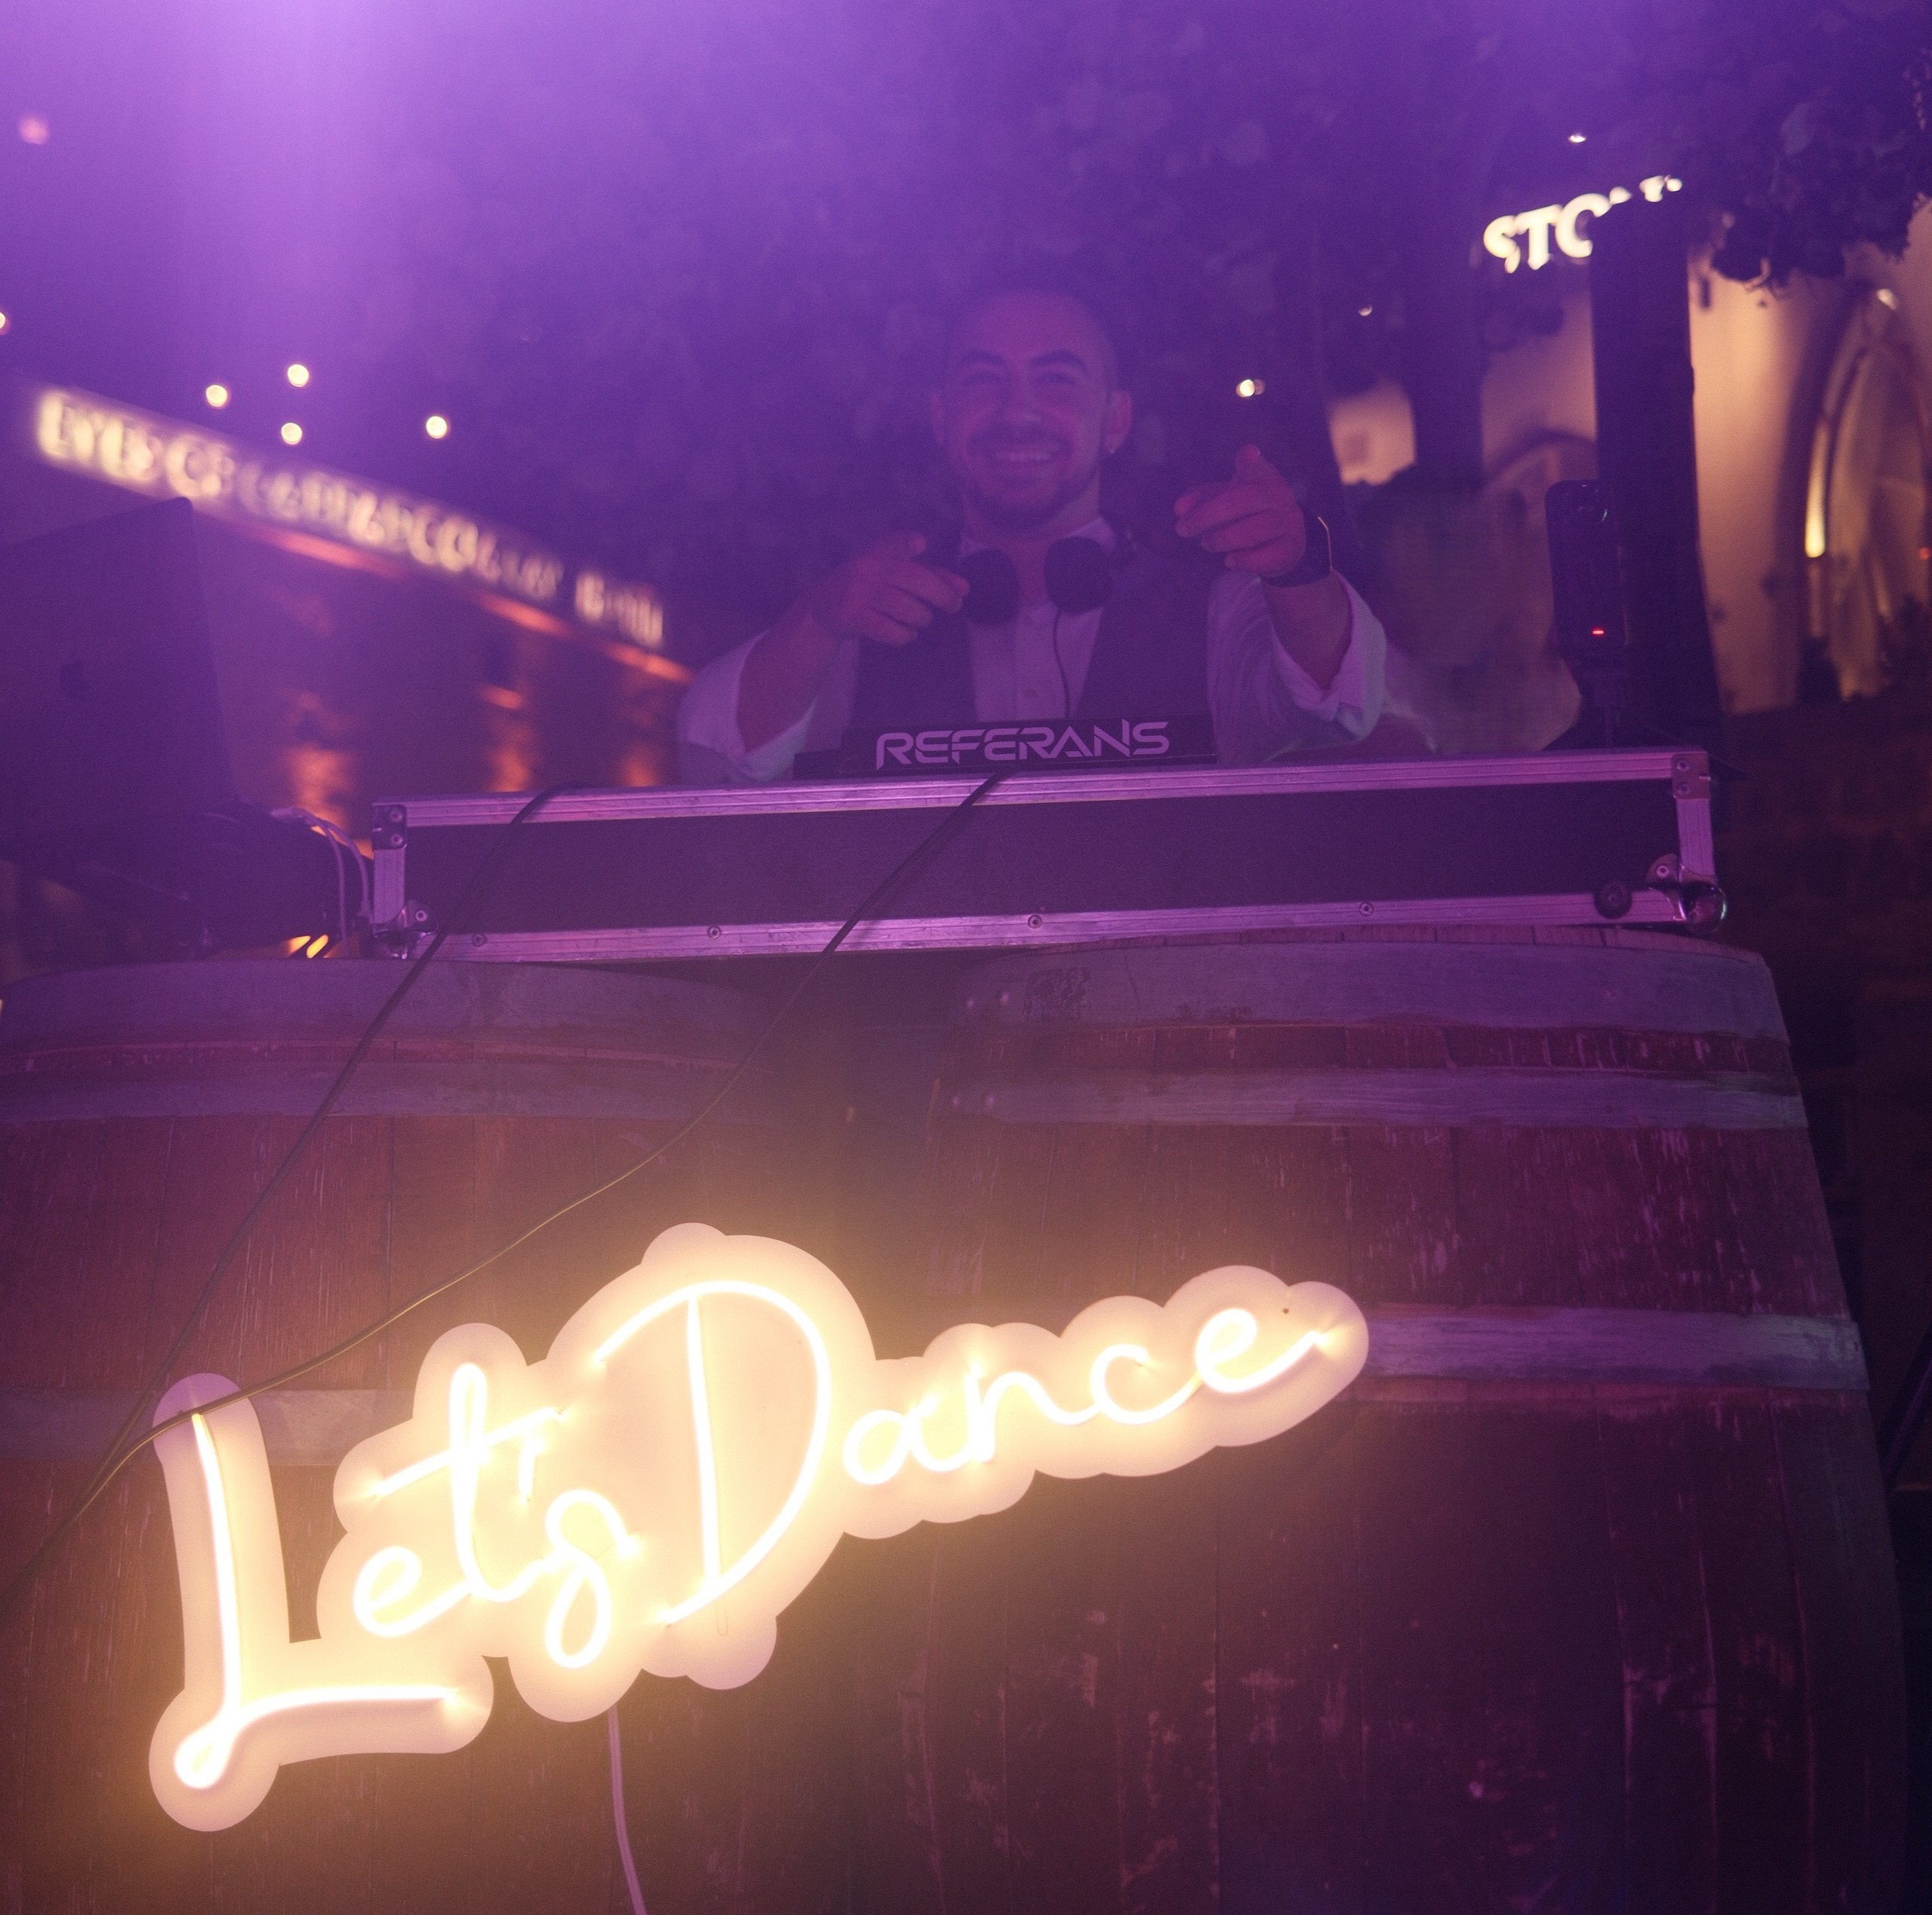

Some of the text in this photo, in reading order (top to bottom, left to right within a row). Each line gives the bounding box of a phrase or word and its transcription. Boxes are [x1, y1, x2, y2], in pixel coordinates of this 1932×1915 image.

[875, 718, 1171, 771] REFERANS
[172, 1279, 1330, 1790] Let's Dance
